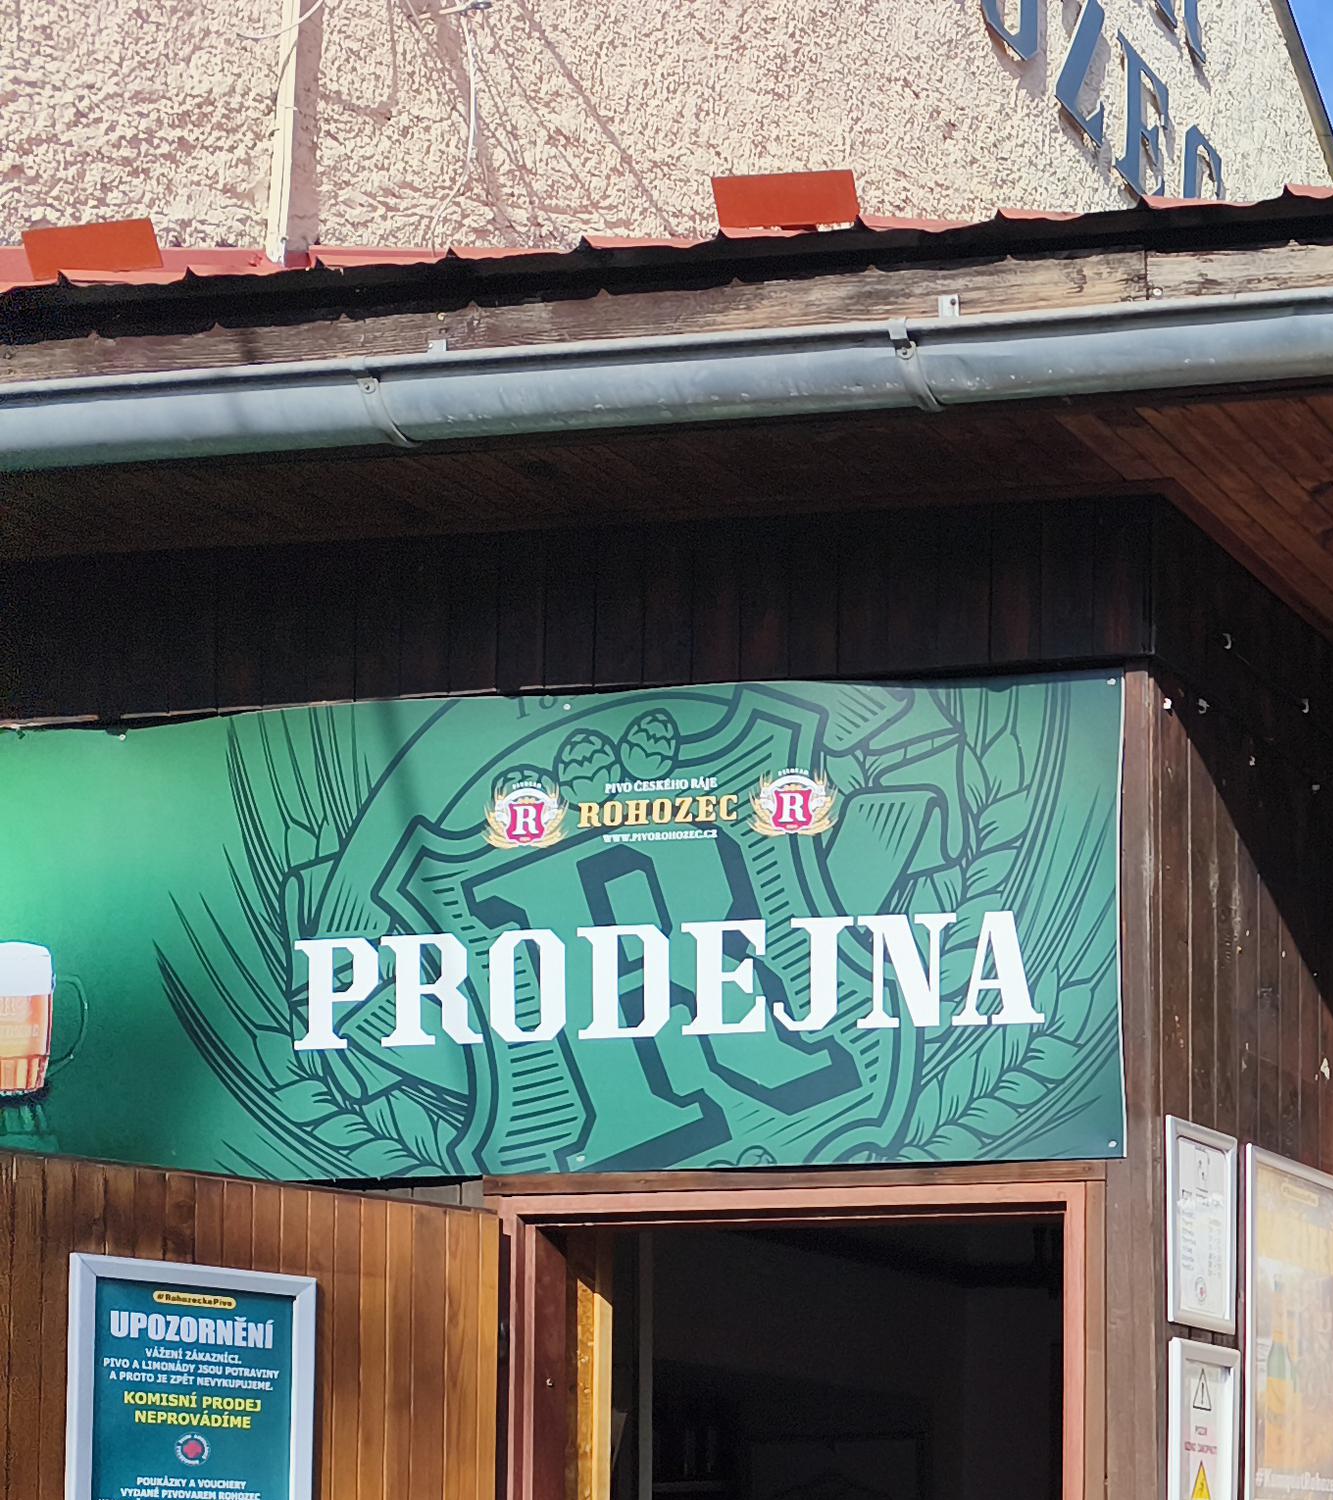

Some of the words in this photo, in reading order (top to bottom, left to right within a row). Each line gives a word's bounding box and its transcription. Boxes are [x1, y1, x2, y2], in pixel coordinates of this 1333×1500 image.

[604, 782, 634, 794] PIVO
[634, 777, 689, 792] ČESKÉHO
[690, 776, 718, 791] RÁJE
[577, 794, 739, 829] ROHOZEC
[293, 909, 1046, 1051] PRODEJNA
[110, 1310, 275, 1350] UPOZORNĚNÍ
[145, 1347, 183, 1361] VÁŽENÍ
[103, 1357, 130, 1368] PIVO
[132, 1359, 140, 1368] A
[141, 1360, 195, 1373] LIMONÁDY
[109, 1371, 117, 1380] A
[119, 1371, 155, 1383] PROTO
[156, 1374, 168, 1384] JE
[169, 1373, 195, 1386] ZPĚT
[123, 1391, 198, 1408] KOMISNÍ
[202, 1396, 262, 1412] PRODEJ
[134, 1410, 252, 1429] NEPROVÁDÍME
[136, 1475, 187, 1488] POUKÁZKY
[188, 1479, 196, 1488] A
